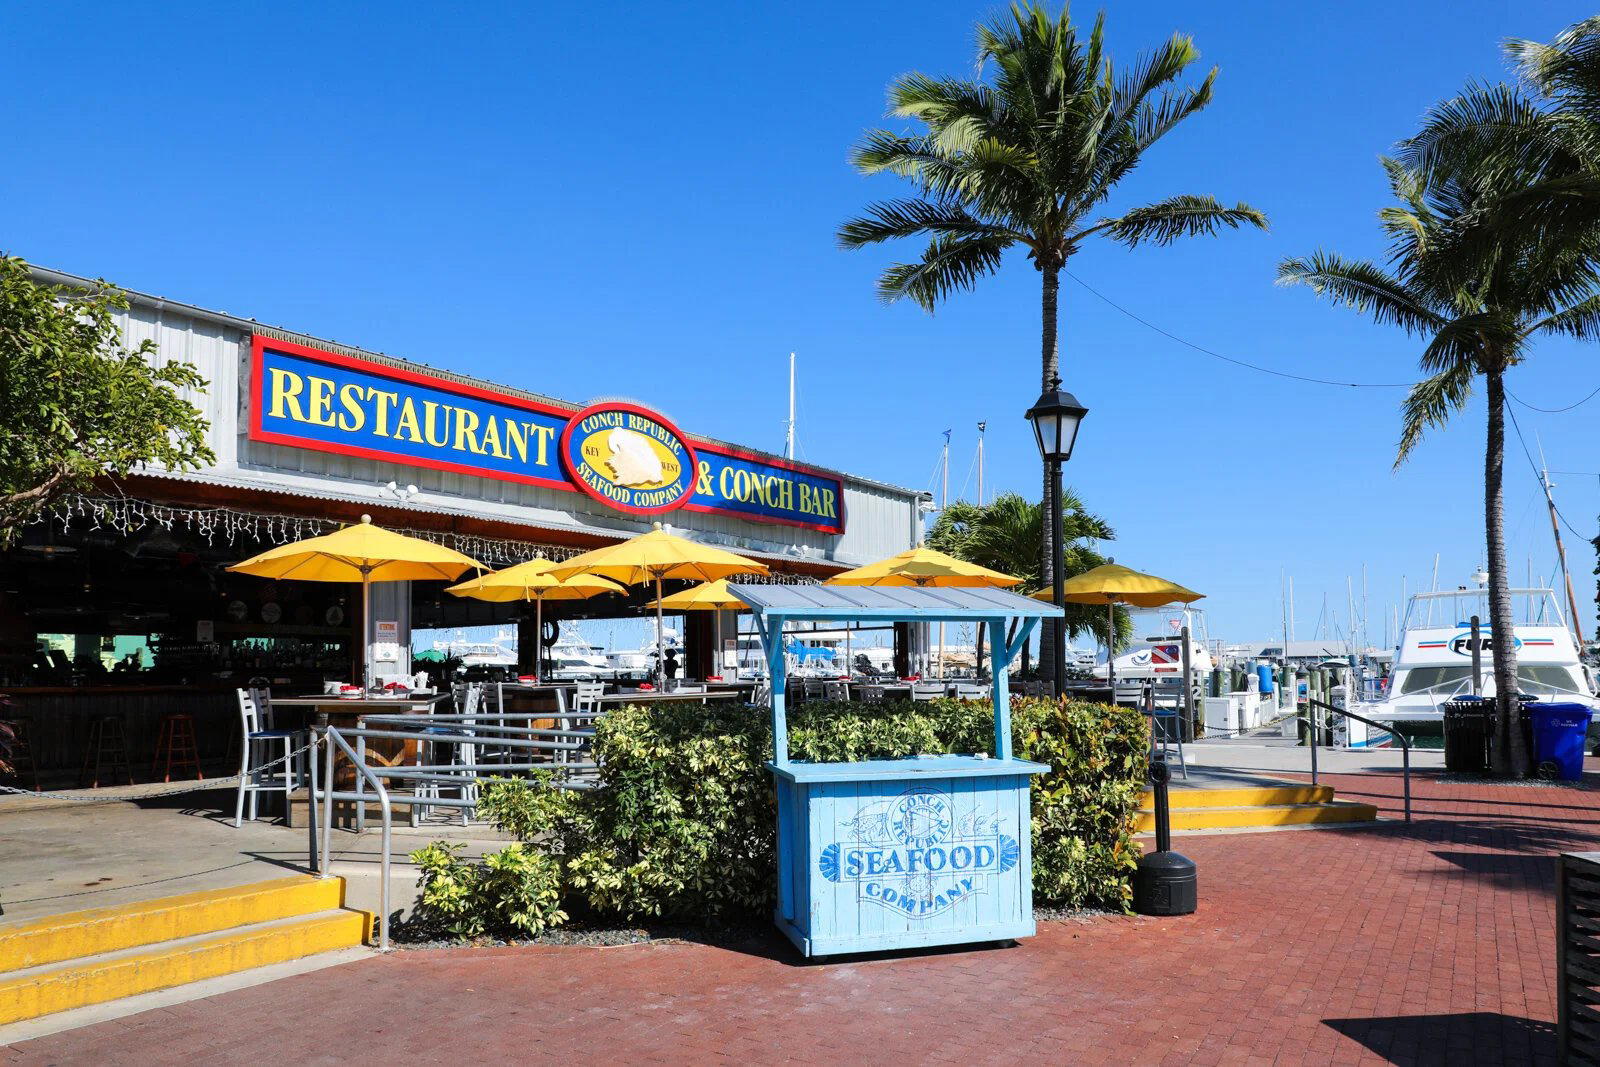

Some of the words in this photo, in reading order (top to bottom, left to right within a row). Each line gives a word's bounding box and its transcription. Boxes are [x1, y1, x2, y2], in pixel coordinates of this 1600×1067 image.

[268, 367, 555, 467] RESTAURANT
[695, 460, 715, 496] &
[720, 466, 795, 511] CONCH
[798, 483, 837, 519] BAR
[581, 411, 624, 434] CONCH
[628, 414, 683, 455] REPUBLIC
[585, 445, 601, 457] KEY
[661, 461, 679, 473] WEST
[576, 462, 631, 503] SEAFOOD
[633, 479, 684, 507] COMPANY
[899, 795, 945, 814] CONCH
[893, 819, 949, 849] REPUBLIC
[846, 845, 995, 876] SEAFOOD
[865, 876, 973, 913] COMPANY
